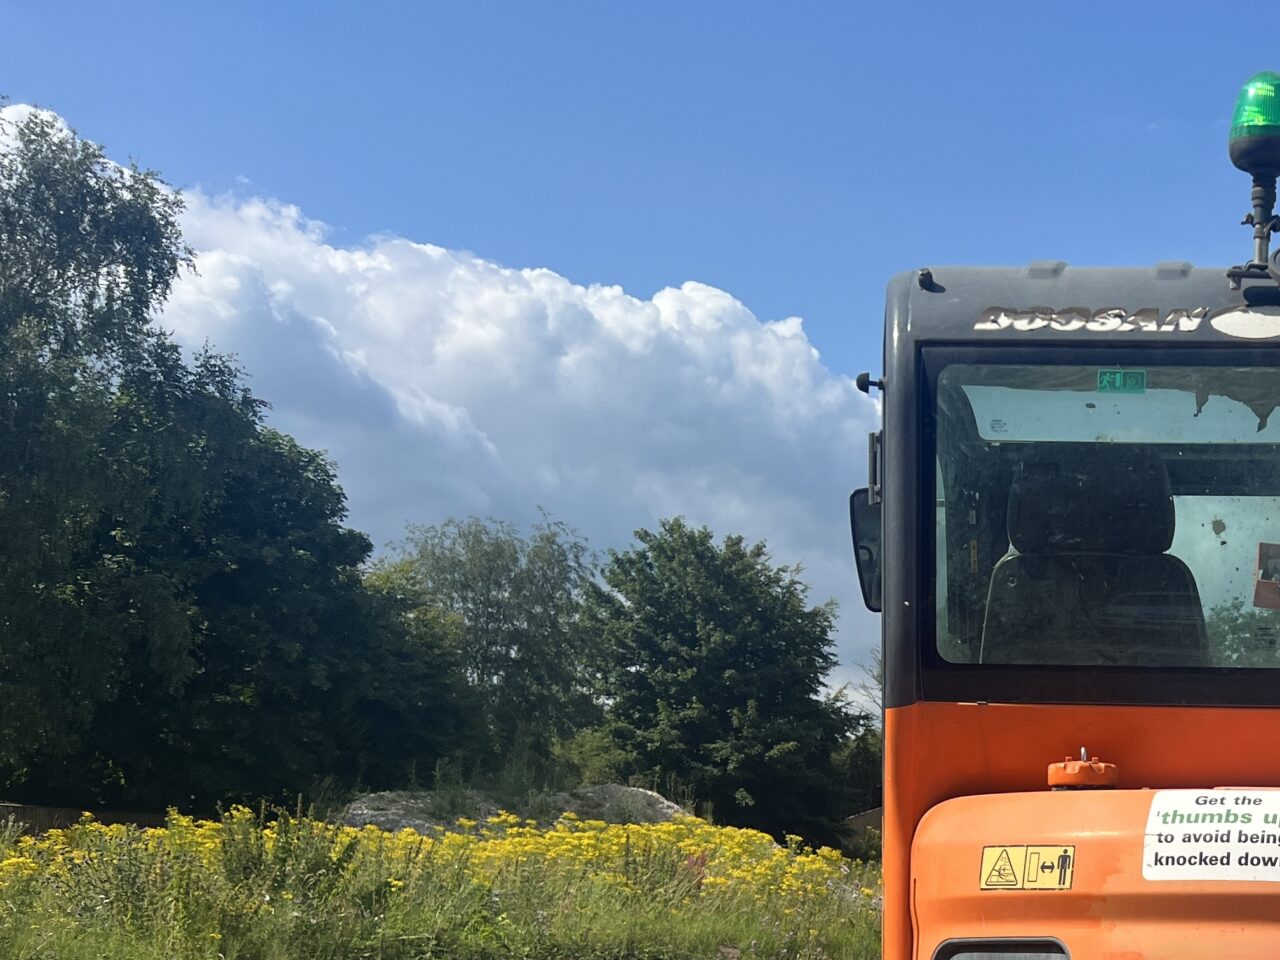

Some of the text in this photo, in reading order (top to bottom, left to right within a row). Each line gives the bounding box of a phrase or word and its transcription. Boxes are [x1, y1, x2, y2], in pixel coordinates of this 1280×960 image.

[1195, 795, 1263, 806] Get the
[1157, 831, 1175, 843] to
[1182, 829, 1231, 843] avoid
[1154, 851, 1231, 866] knocked
